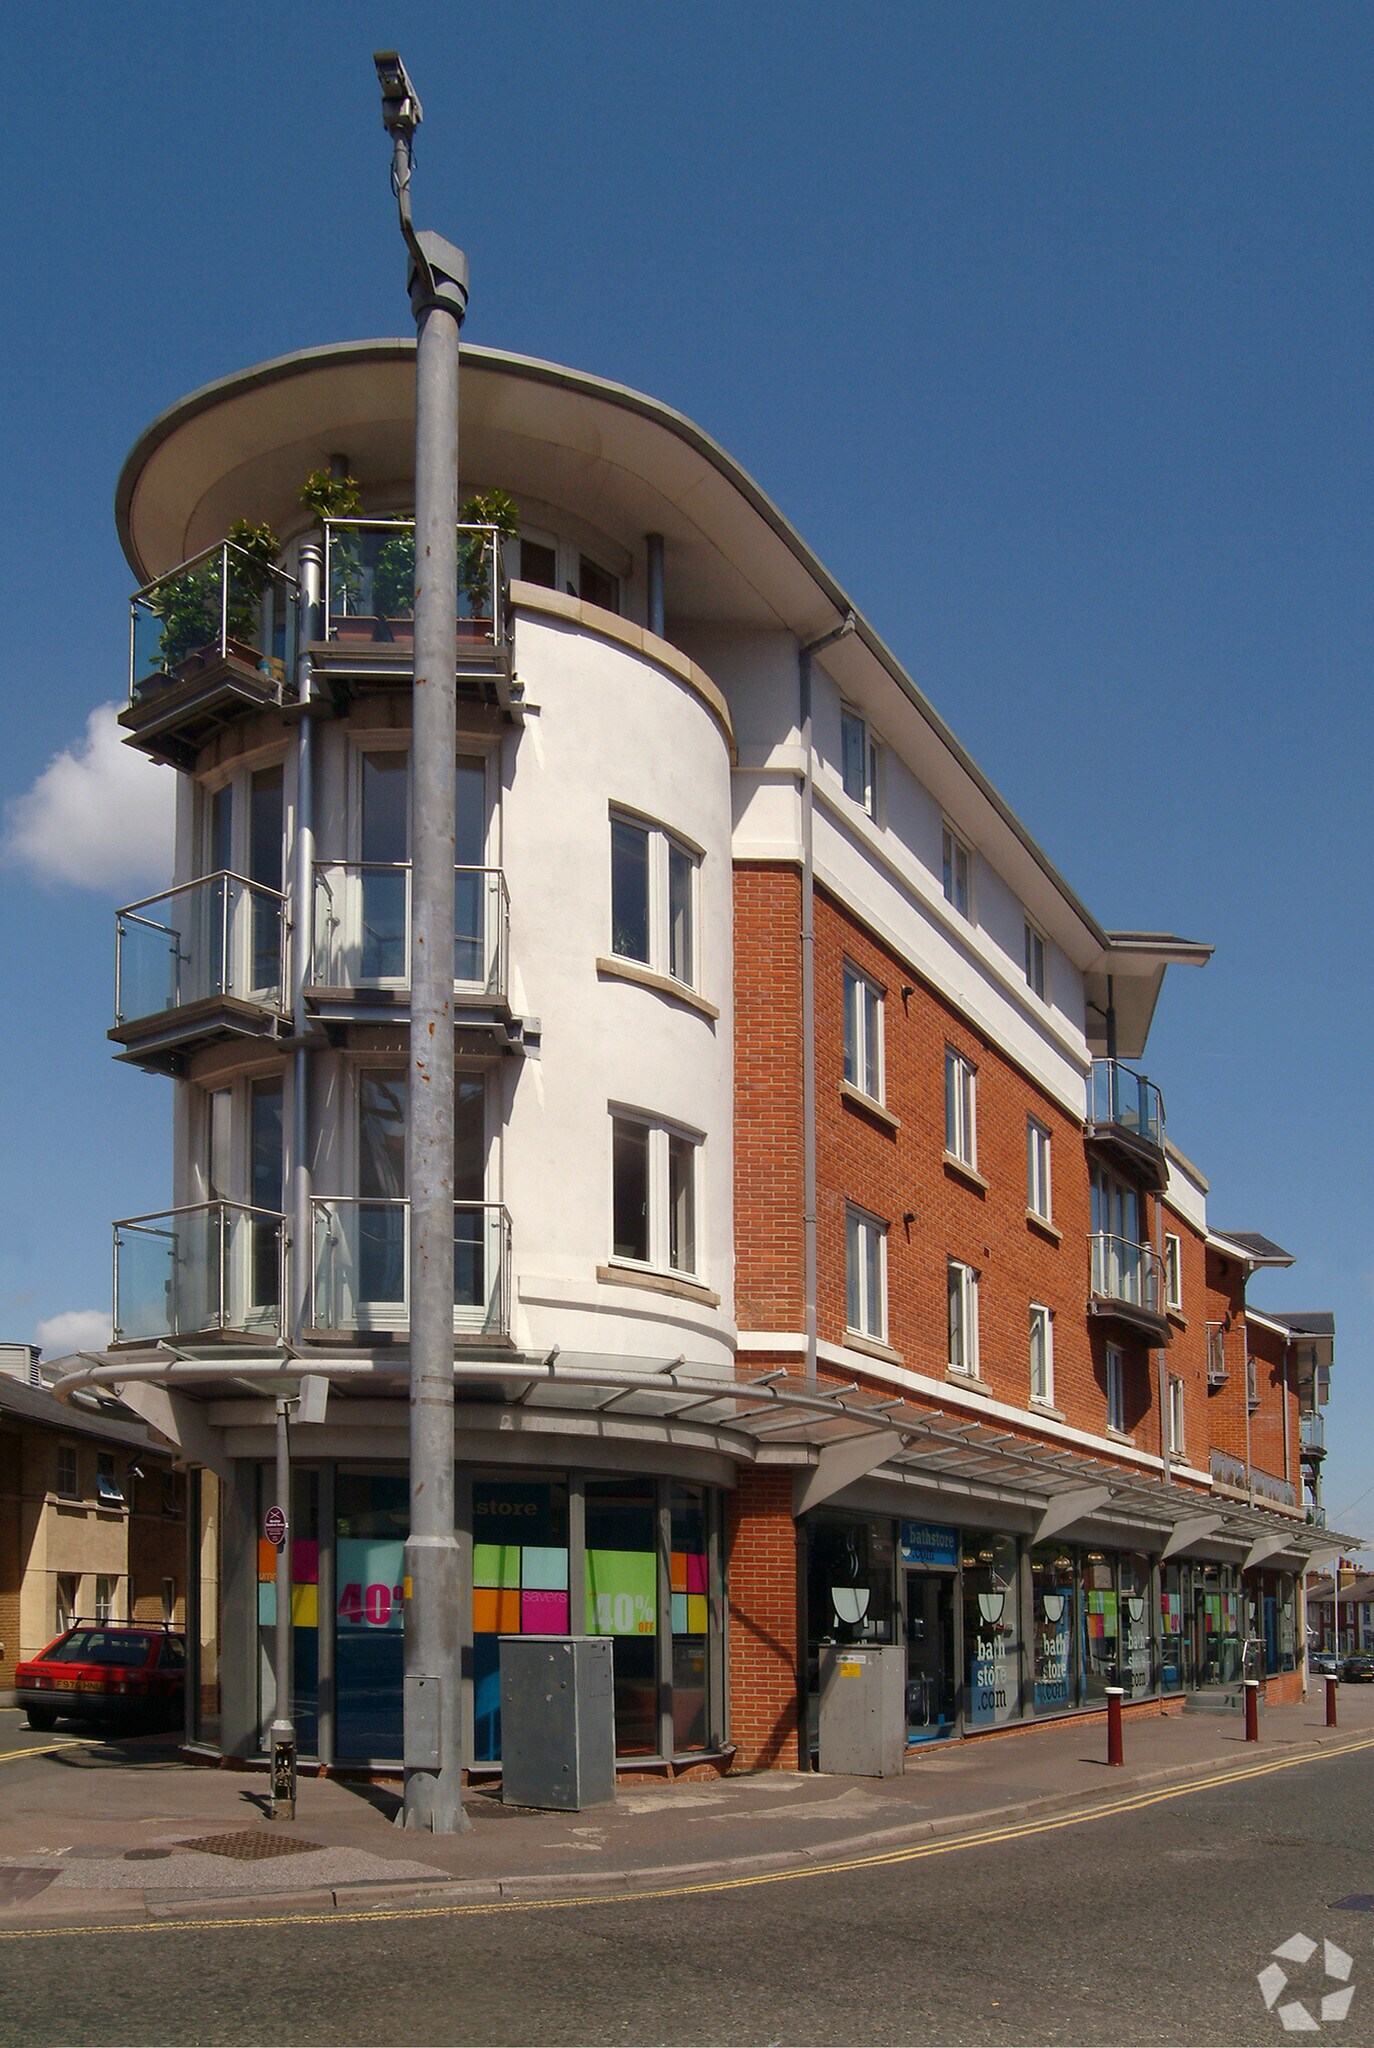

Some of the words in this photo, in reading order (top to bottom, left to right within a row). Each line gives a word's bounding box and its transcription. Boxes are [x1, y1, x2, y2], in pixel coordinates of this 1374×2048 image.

[910, 1525, 955, 1549] bathstore
[521, 1590, 569, 1604] savers
[592, 1592, 655, 1633] 40%
[638, 1621, 655, 1634] OFF
[977, 1634, 1007, 1662] bath
[1042, 1632, 1068, 1657] bath
[977, 1664, 1008, 1687] store
[1042, 1659, 1067, 1680] store
[978, 1689, 1008, 1711] .com
